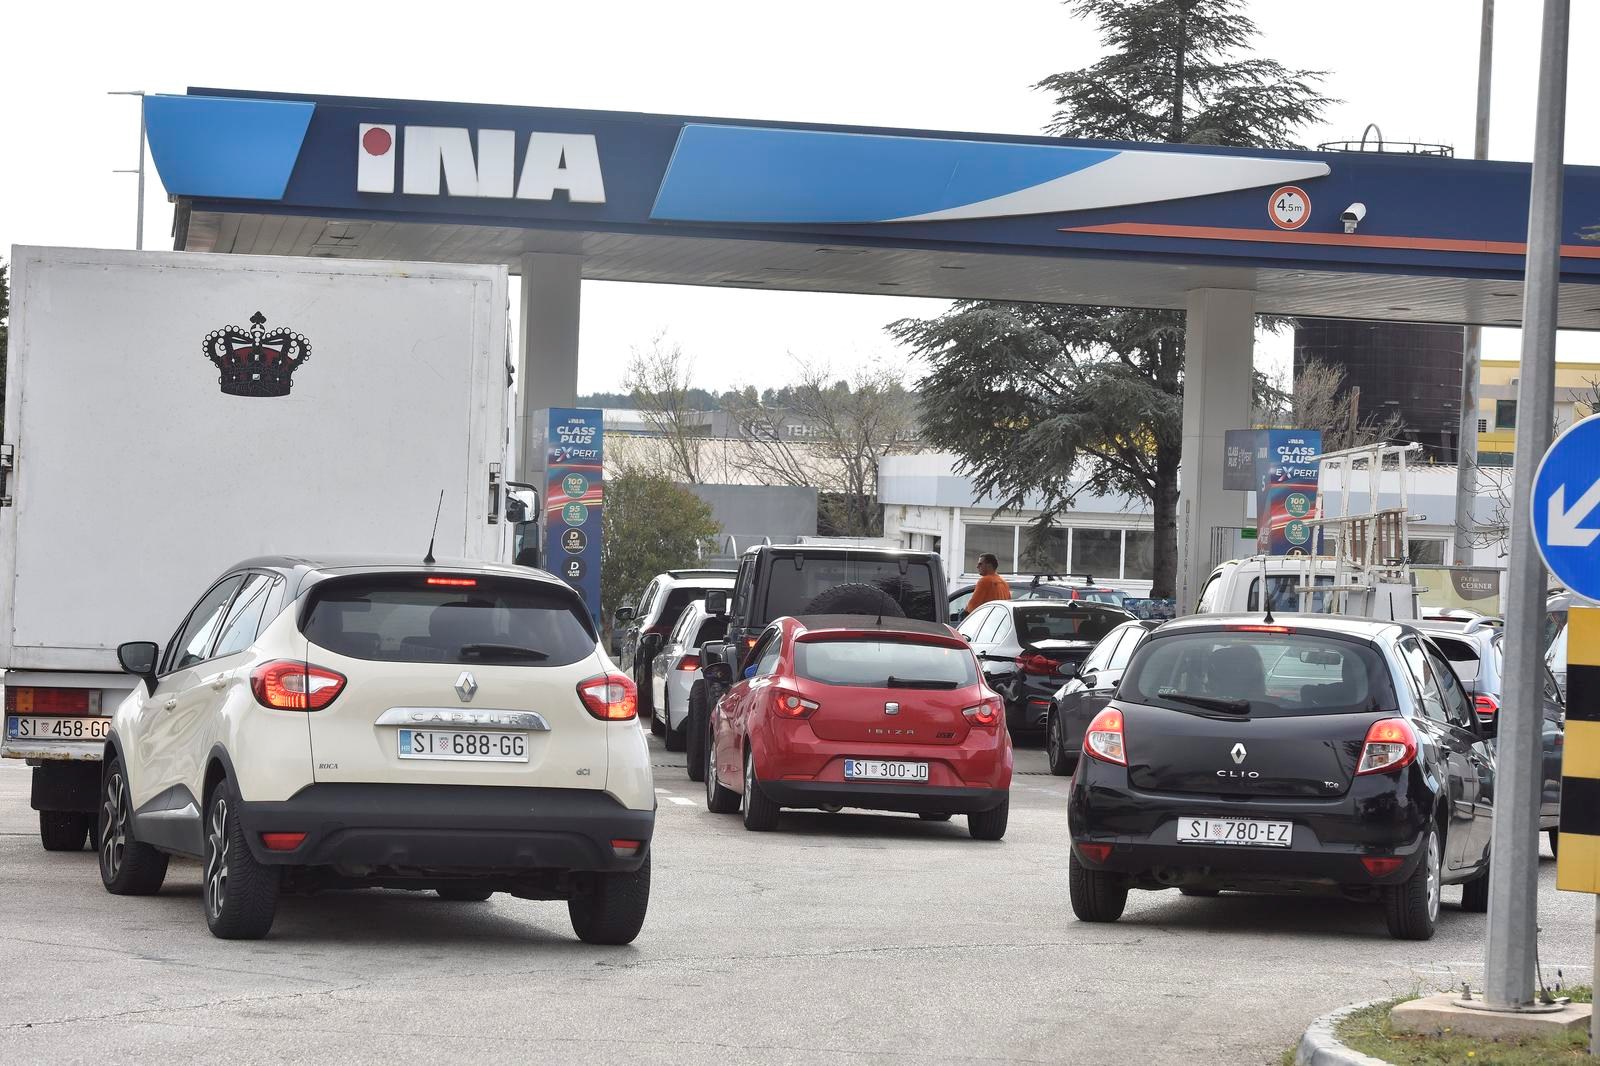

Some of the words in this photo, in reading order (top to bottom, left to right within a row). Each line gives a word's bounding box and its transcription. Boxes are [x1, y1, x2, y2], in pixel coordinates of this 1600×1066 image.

[556, 425, 596, 436] CLASS
[560, 434, 592, 444] PLUS
[1277, 446, 1315, 456] CLASS
[1281, 454, 1312, 464] PLUS
[1290, 497, 1305, 505] 100
[569, 505, 580, 513] 95
[570, 531, 579, 540] D
[571, 561, 579, 570] D
[411, 711, 520, 725] CAPTUR
[414, 731, 433, 753] ŠI
[453, 734, 524, 756] 688-GG
[880, 763, 927, 778] 300-JD
[1216, 770, 1259, 778] CLIO
[1224, 822, 1289, 841] 780-EZ
